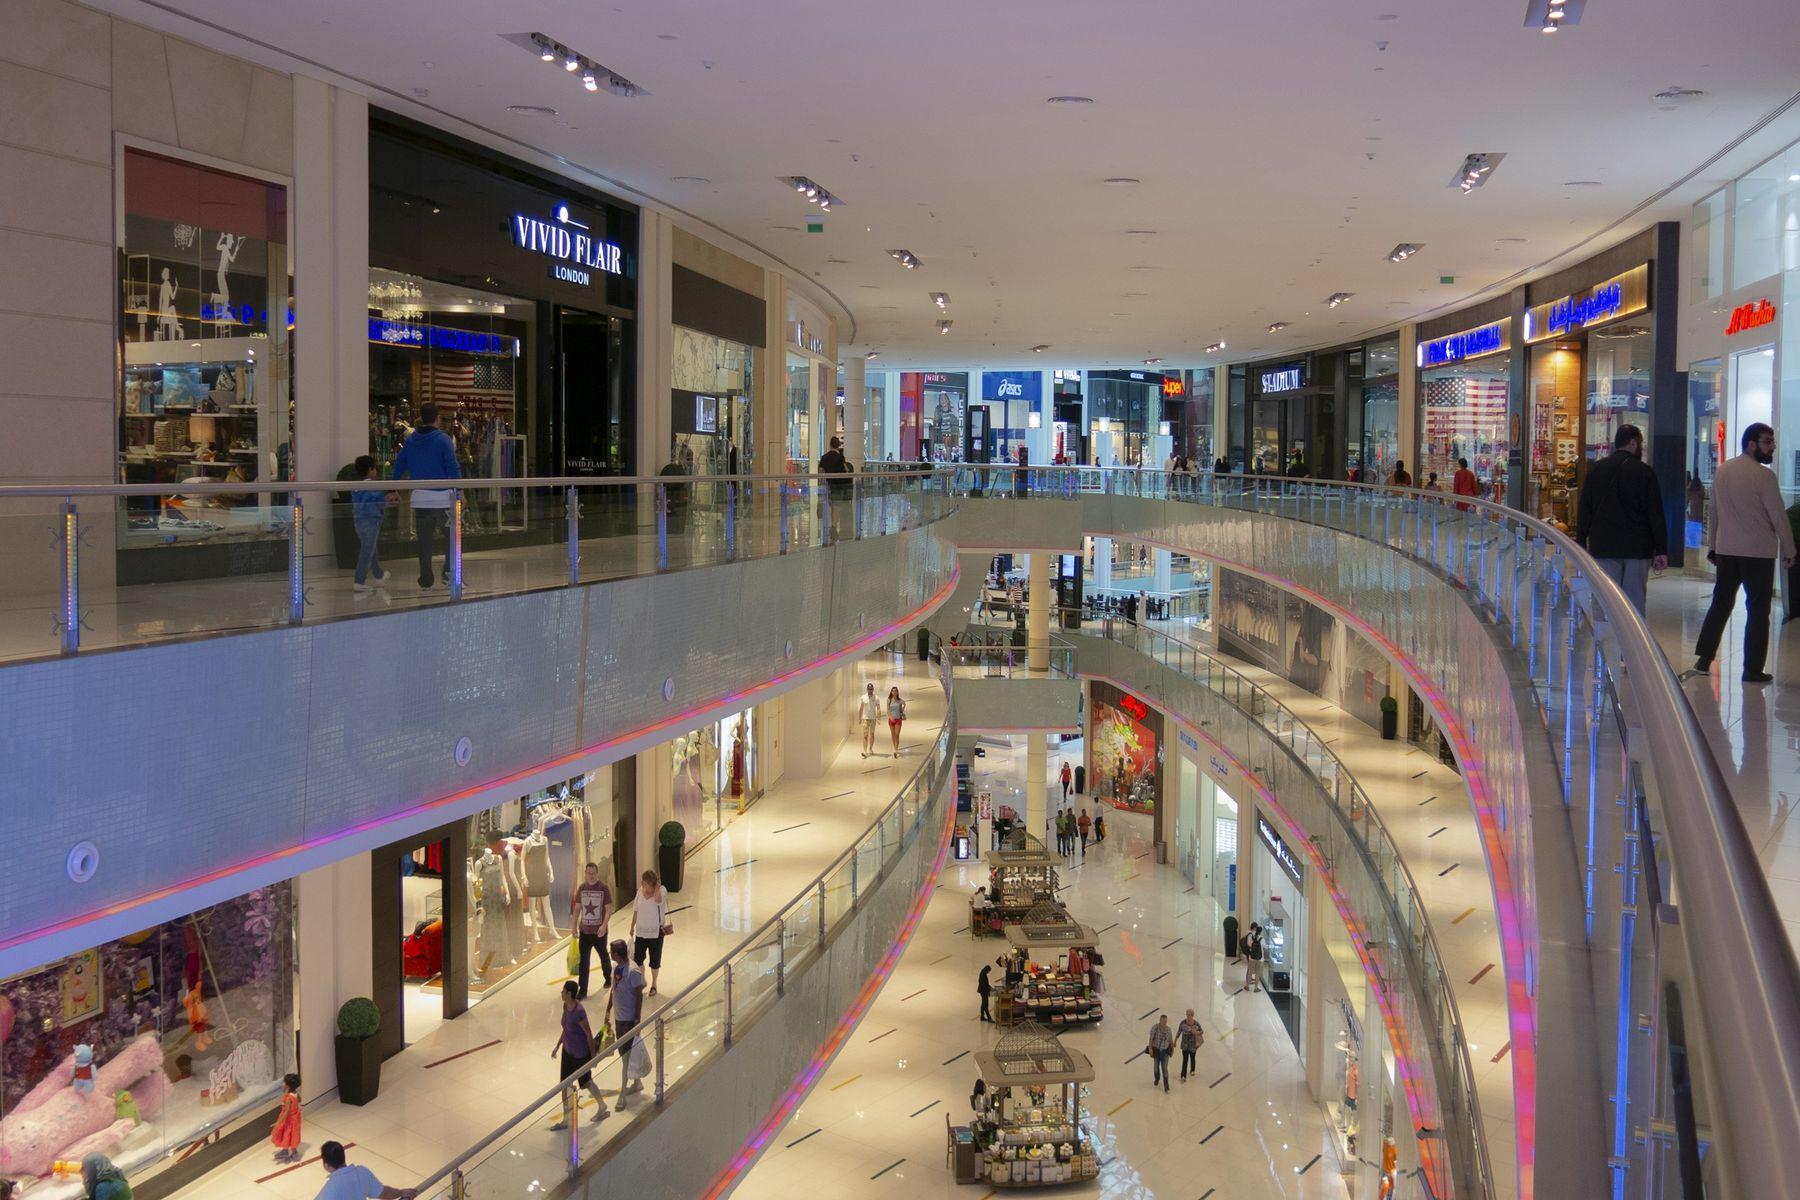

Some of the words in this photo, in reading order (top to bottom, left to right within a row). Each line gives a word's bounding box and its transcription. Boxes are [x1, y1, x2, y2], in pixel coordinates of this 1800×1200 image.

[517, 216, 571, 259] VIVID
[576, 234, 621, 275] FLAIR
[555, 265, 589, 286] LONDON
[1262, 369, 1299, 393] STADIUM
